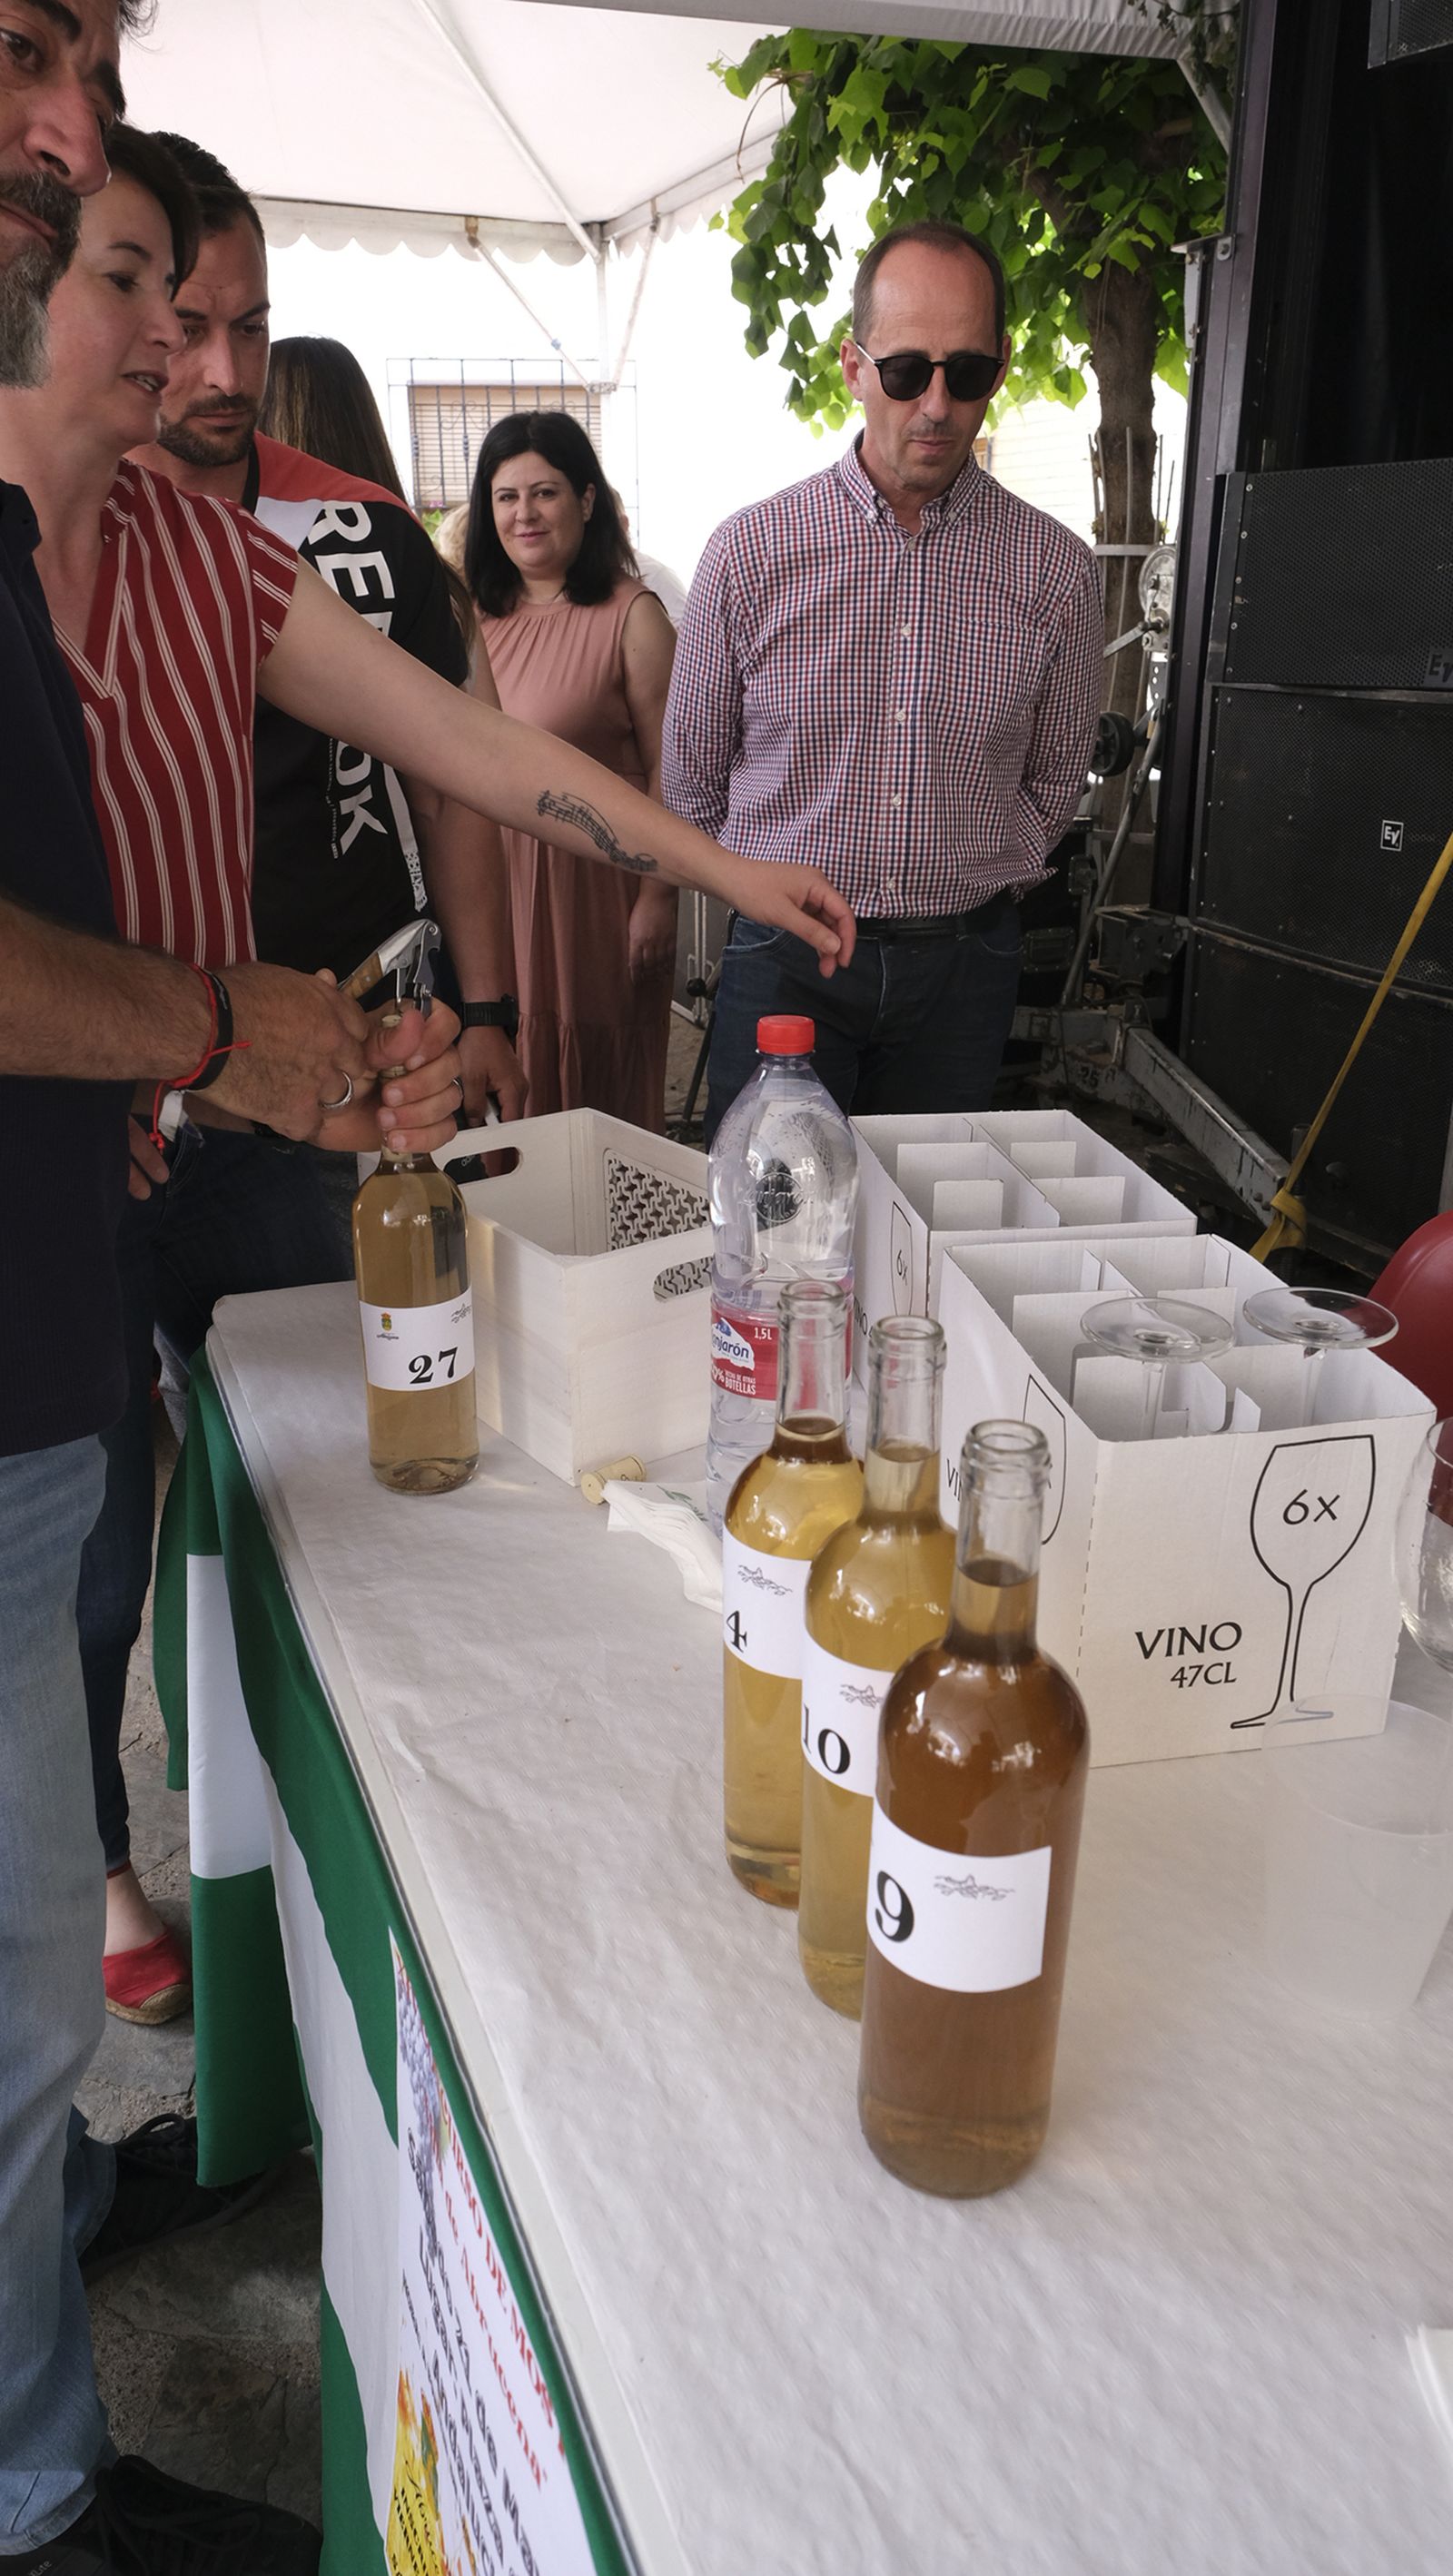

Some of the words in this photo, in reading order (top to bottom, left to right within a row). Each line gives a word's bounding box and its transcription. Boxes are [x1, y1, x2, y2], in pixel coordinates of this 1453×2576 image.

[408, 1347, 458, 1385] 27
[726, 1610, 747, 1653] 4
[1135, 1622, 1242, 1660] VINO
[1170, 1662, 1238, 1689] 47CL
[804, 1703, 851, 1774] 10
[875, 1870, 915, 1943] 9
